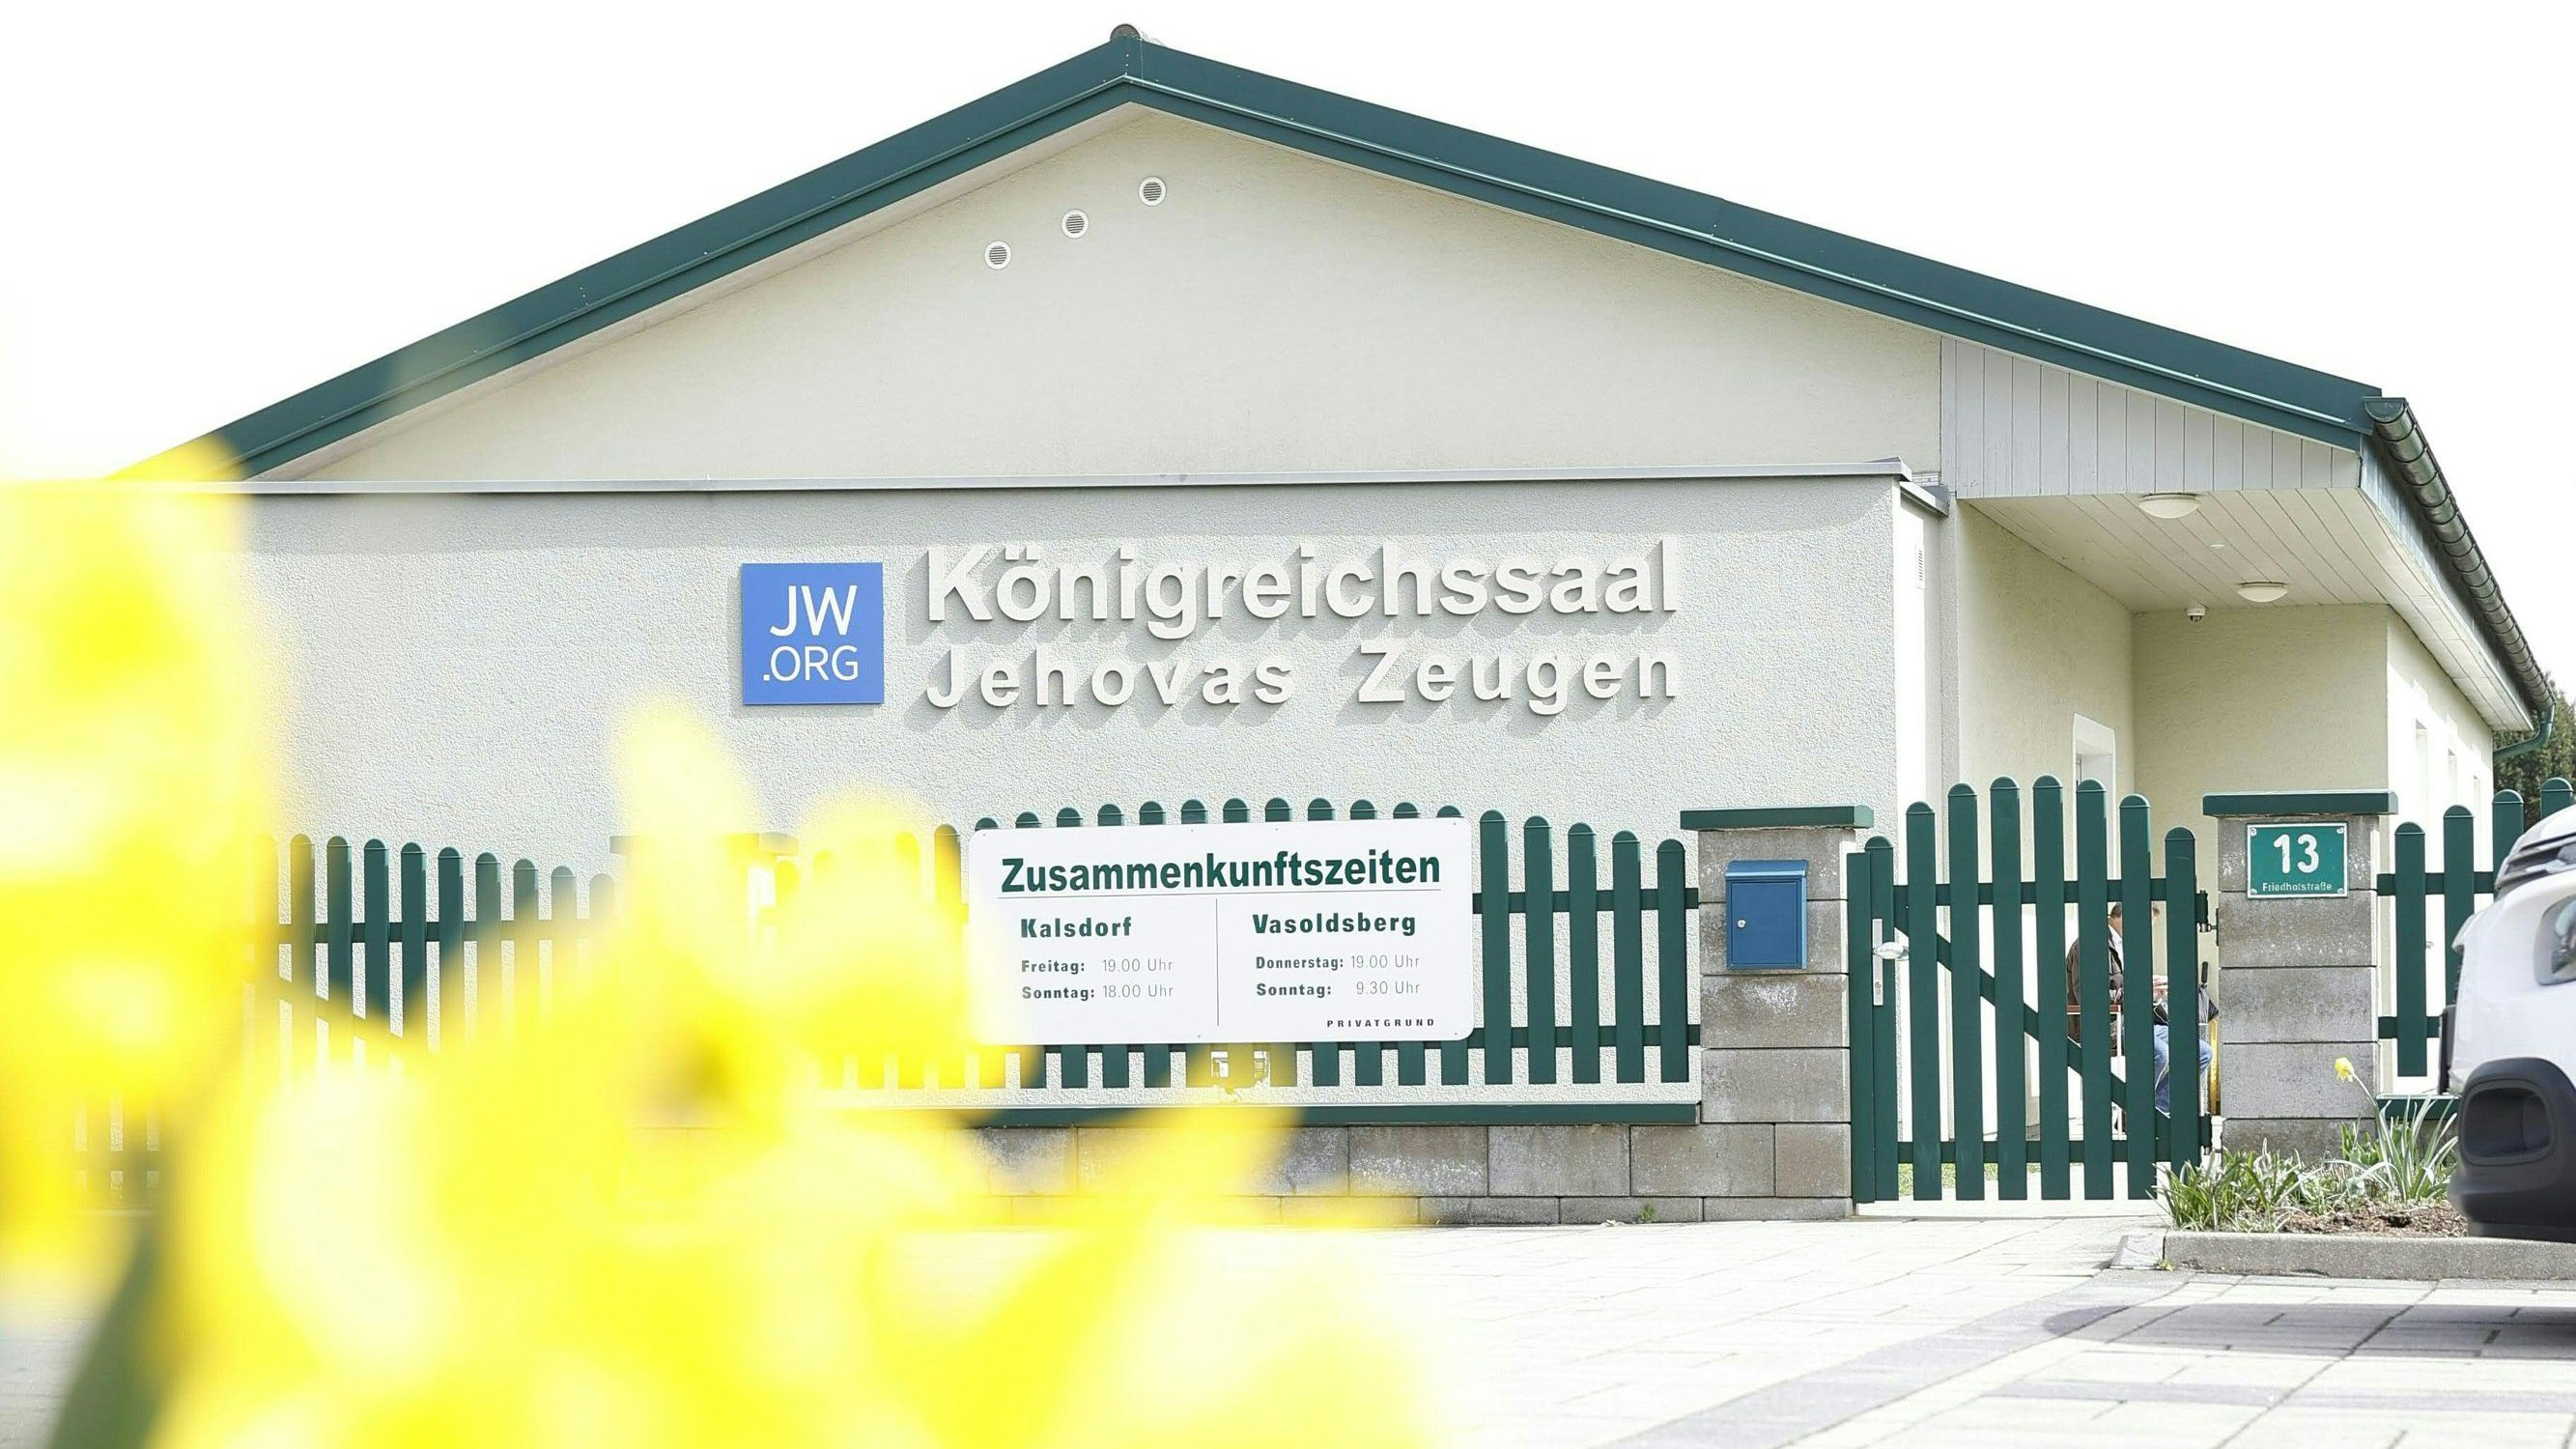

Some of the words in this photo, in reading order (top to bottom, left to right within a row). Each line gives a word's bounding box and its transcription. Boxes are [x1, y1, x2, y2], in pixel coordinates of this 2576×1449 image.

[926, 537, 1679, 640] Königreichssaal
[770, 585, 856, 638] JW
[762, 644, 860, 683] .ORG
[926, 646, 1294, 708] Jehovas
[1358, 639, 1679, 718] Zeugen
[2273, 834, 2319, 874] 13
[1001, 848, 1441, 894] Zusammenkunftszeiten
[2262, 881, 2333, 892] Friedhofstraße
[1020, 916, 1132, 938] Kalsdorf
[1252, 912, 1416, 936] Vasoldsberg
[1022, 959, 1085, 975] Freitag:
[1102, 959, 1141, 972] 19.00
[1147, 958, 1173, 972] Uhr
[1256, 955, 1344, 971] Donnerstag:
[1351, 954, 1388, 969] 19.00
[1396, 953, 1420, 968] Uhr
[1022, 985, 1094, 1001] Sonntag:
[1103, 984, 1141, 998] 18.00
[1147, 983, 1174, 997] Uhr
[1256, 981, 1332, 998] Sonntag:
[1355, 981, 1388, 995] 9.30
[1396, 980, 1420, 994] Uhr
[1326, 1018, 1435, 1028] PRIVATGRUND
